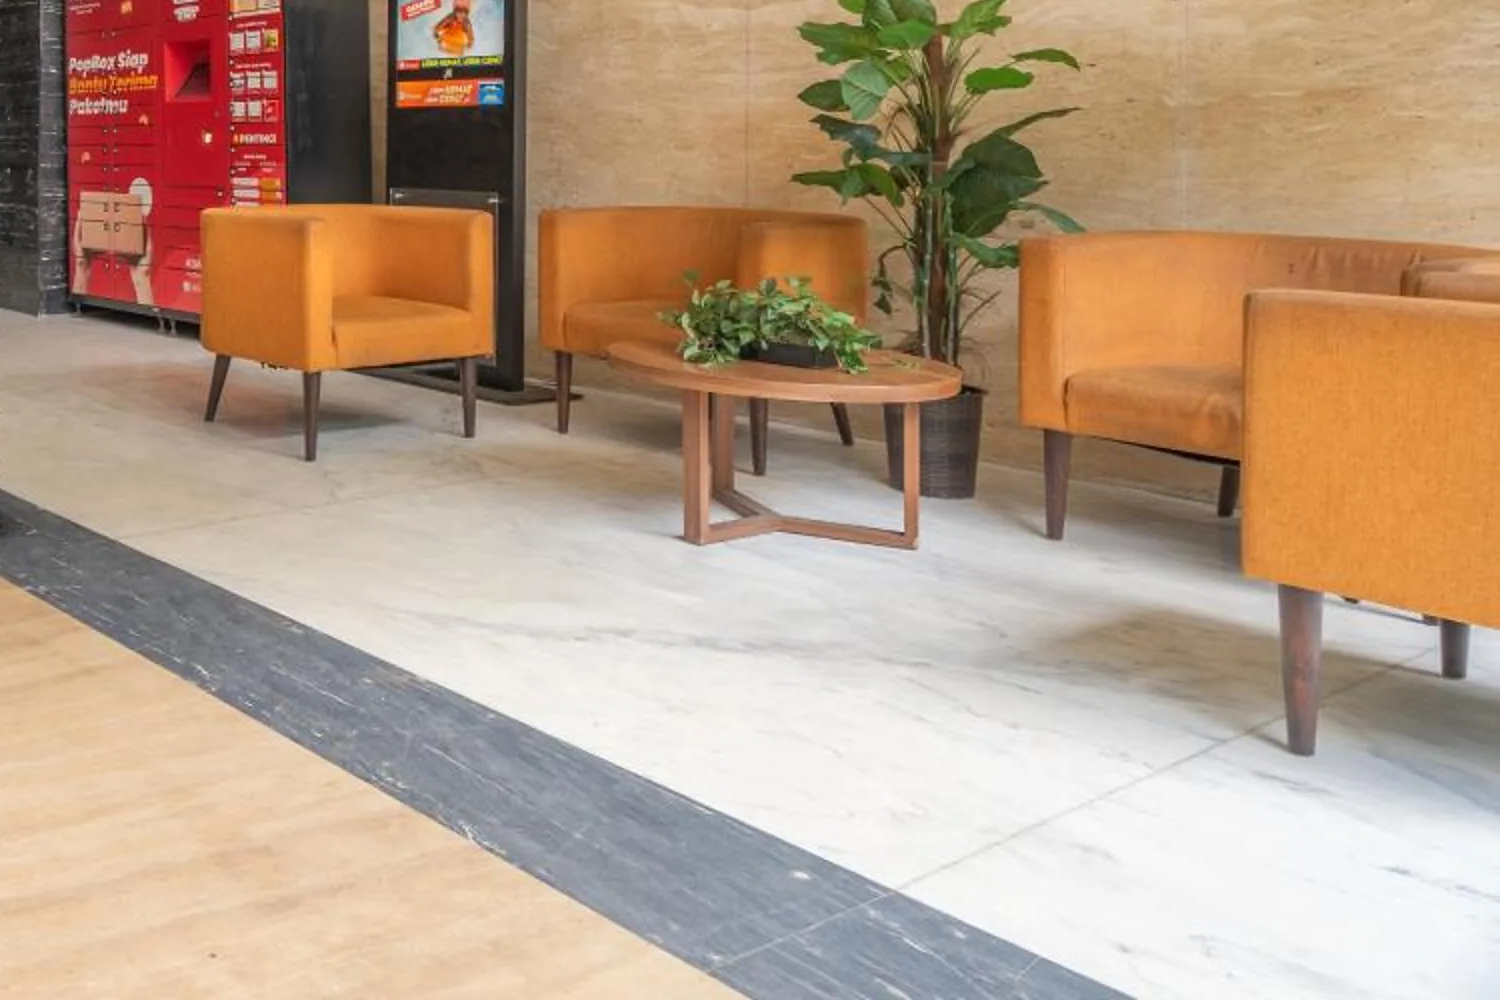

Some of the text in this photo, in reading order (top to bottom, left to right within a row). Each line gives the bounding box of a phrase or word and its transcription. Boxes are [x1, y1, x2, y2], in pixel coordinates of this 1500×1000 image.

[69, 49, 149, 78] PopBox Siap
[69, 97, 128, 116] Paketmu
